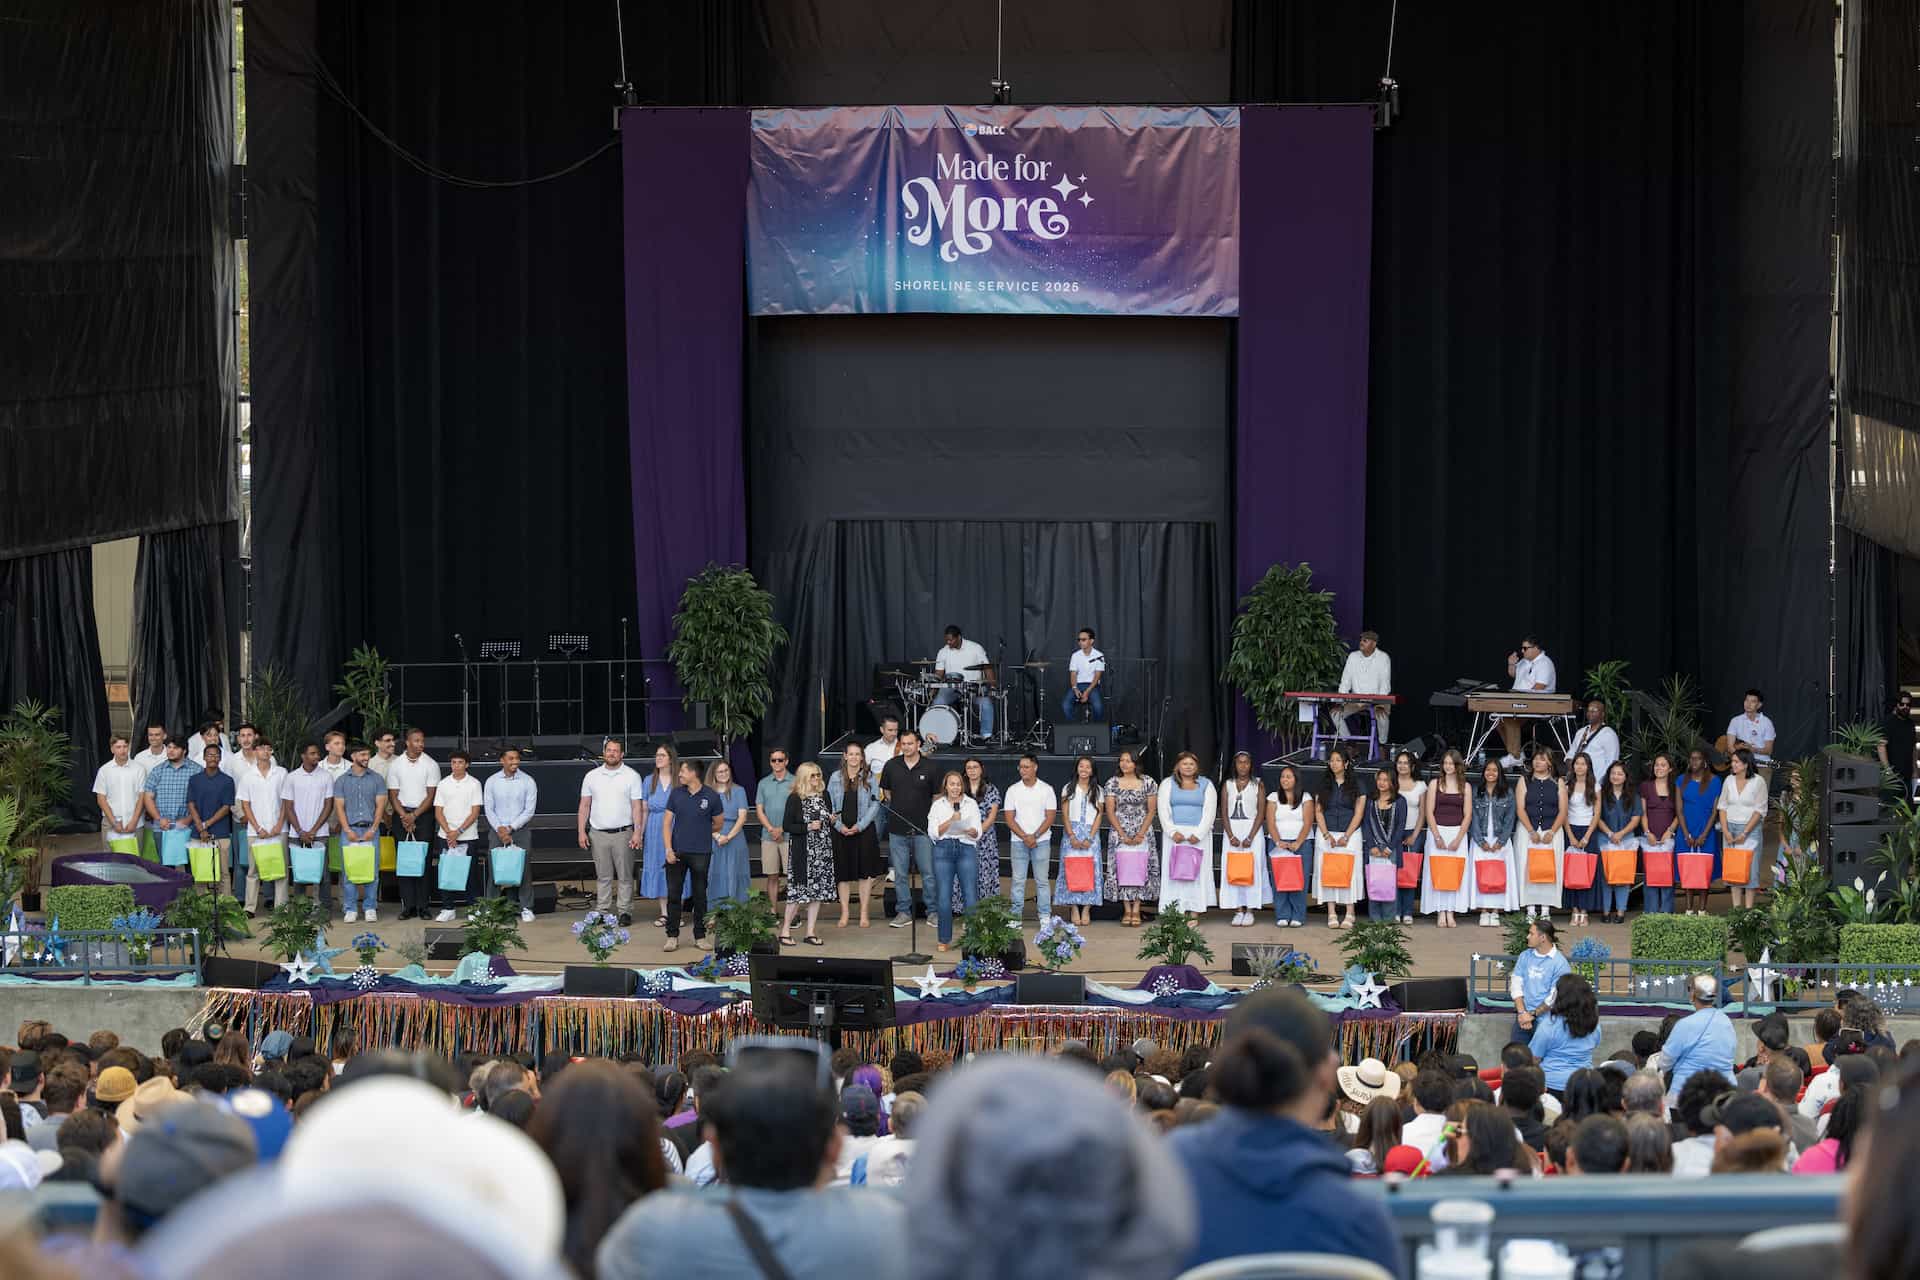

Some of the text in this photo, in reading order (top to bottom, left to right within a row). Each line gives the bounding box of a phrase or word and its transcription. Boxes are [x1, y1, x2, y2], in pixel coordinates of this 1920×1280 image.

[979, 125, 1005, 136] BACC
[936, 152, 1052, 182] Made for
[901, 176, 1070, 263] More
[895, 280, 972, 291] SHORELINE
[978, 281, 1039, 292] SERVICE
